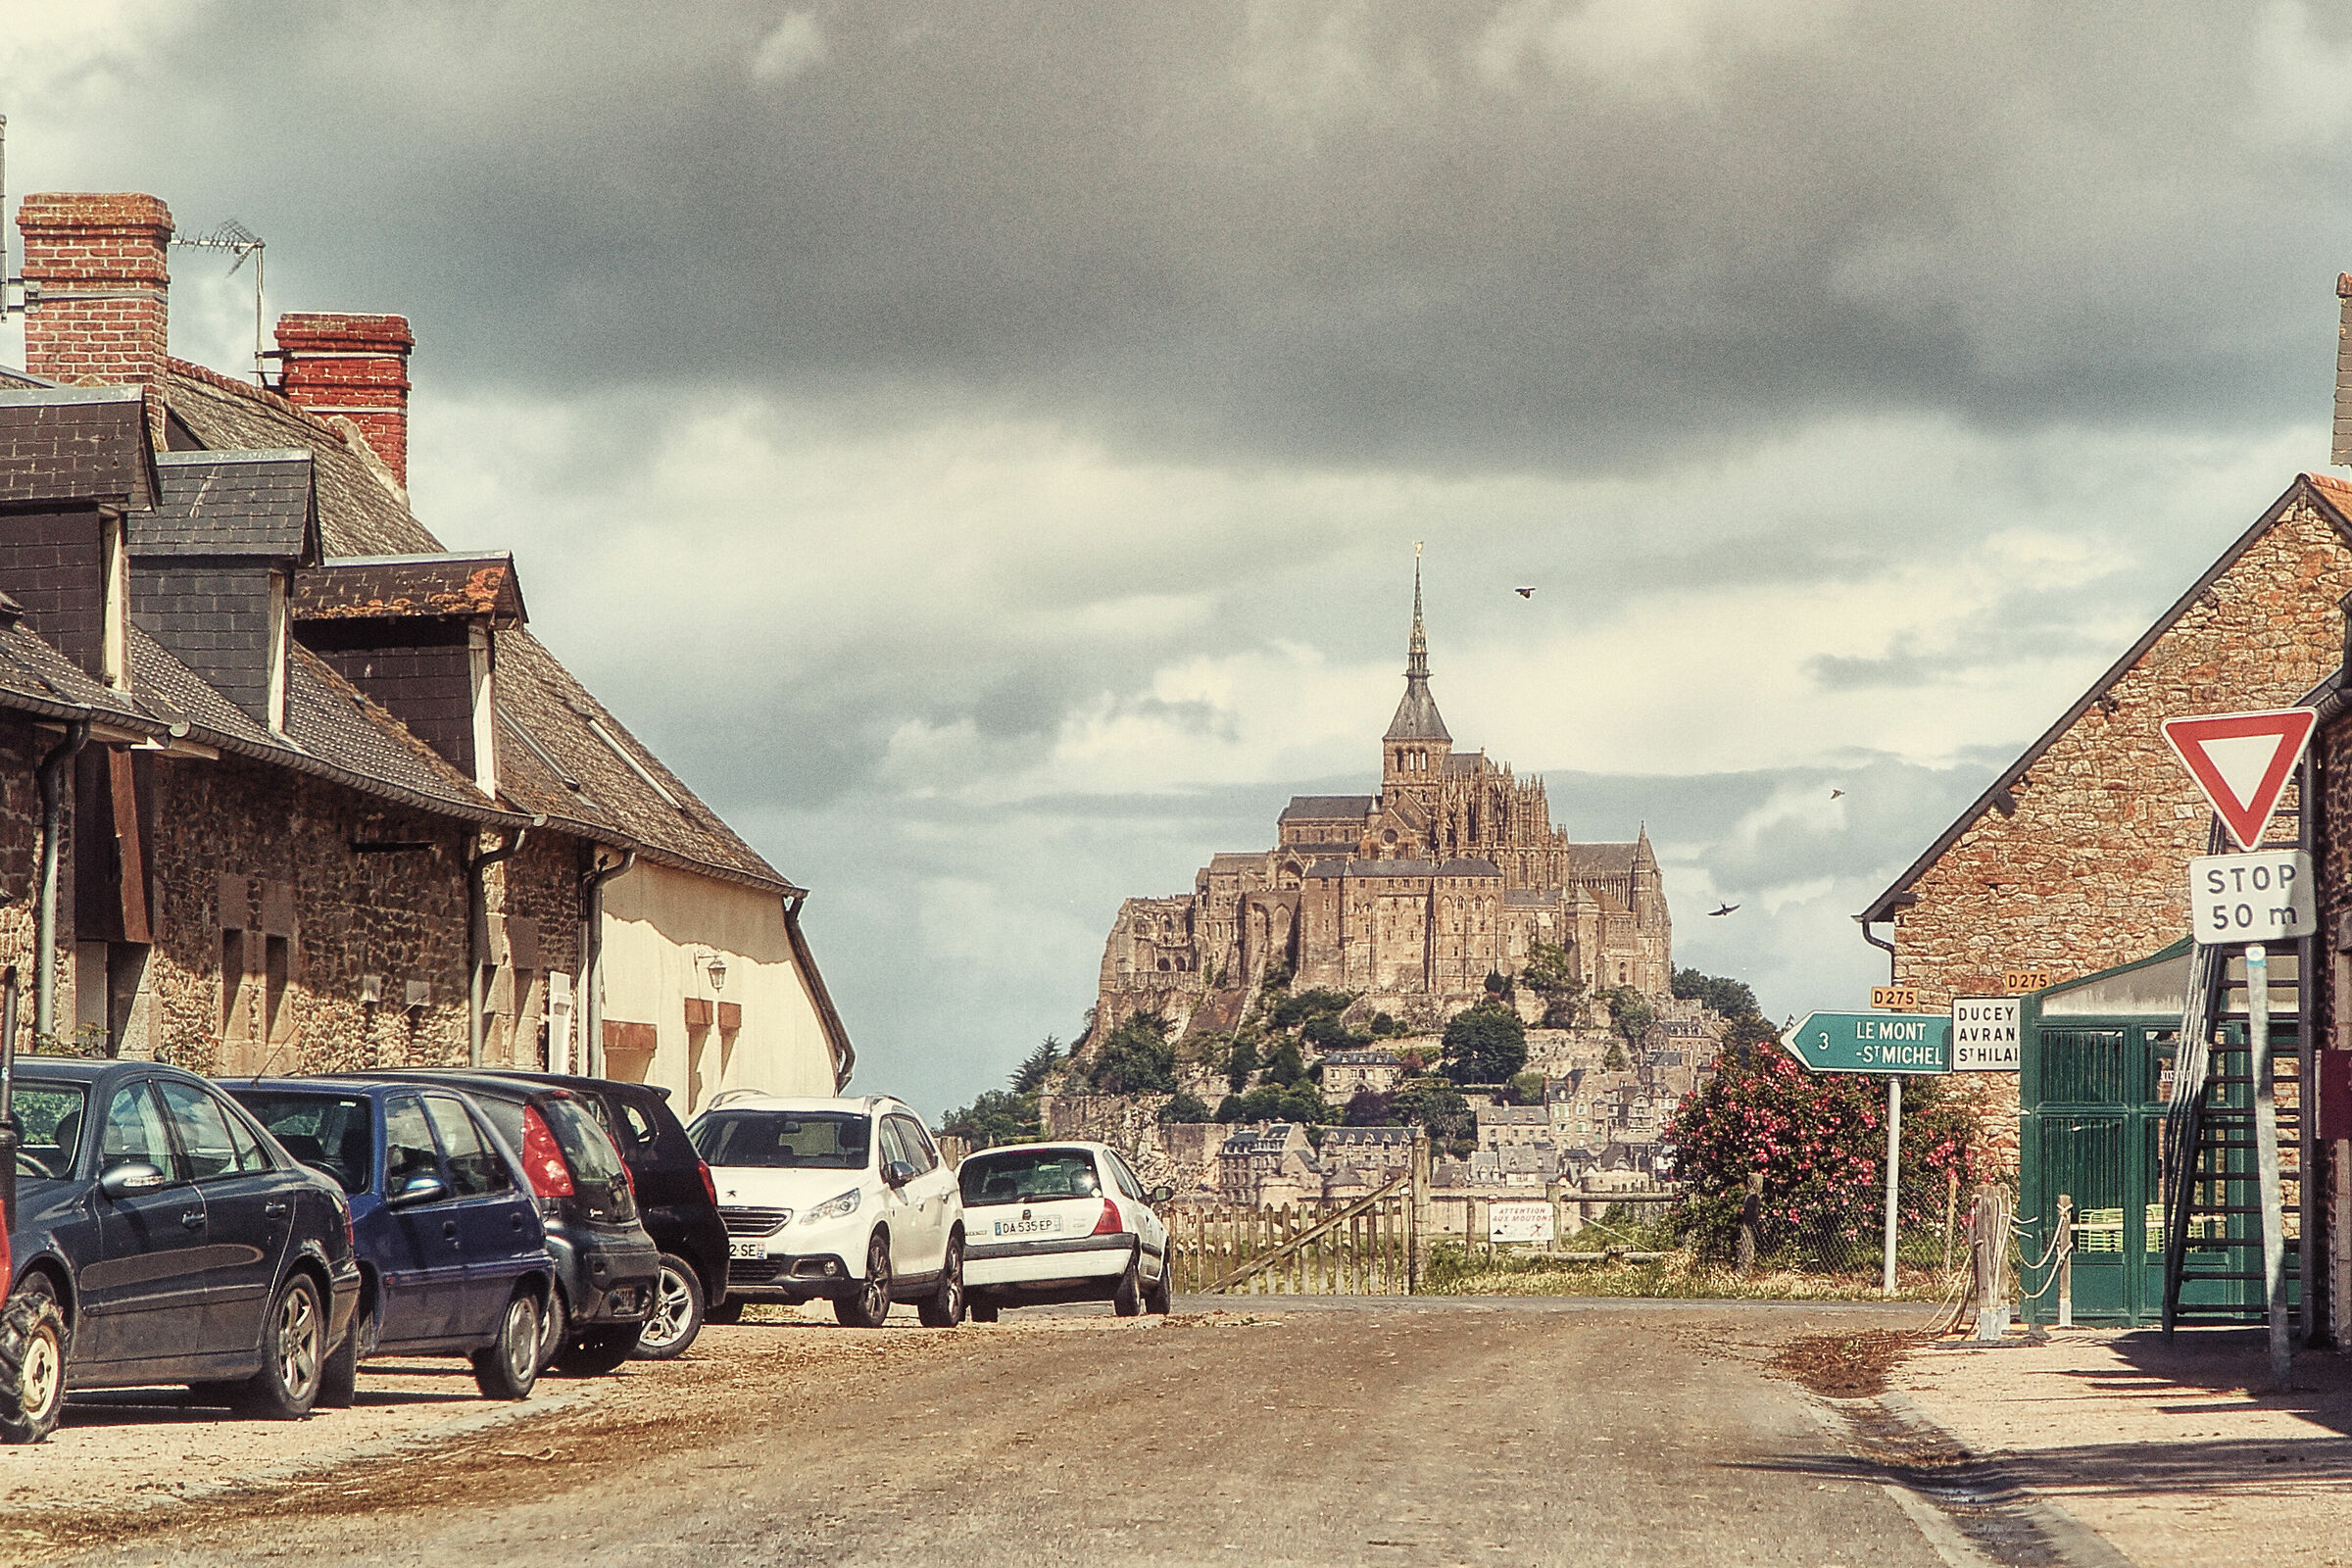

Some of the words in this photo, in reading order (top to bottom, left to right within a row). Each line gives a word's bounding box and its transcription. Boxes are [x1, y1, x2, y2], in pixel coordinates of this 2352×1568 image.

[2206, 863, 2297, 895] STOP
[2212, 903, 2254, 930] 50
[2270, 905, 2298, 926] m
[1958, 1006, 2015, 1021] DUCEY
[1817, 1031, 1830, 1051] 3
[1856, 1021, 1876, 1040] LE
[1879, 1021, 1927, 1041] MONT
[1958, 1027, 2016, 1042] AVRAN
[1881, 1045, 1943, 1065] MICHEL
